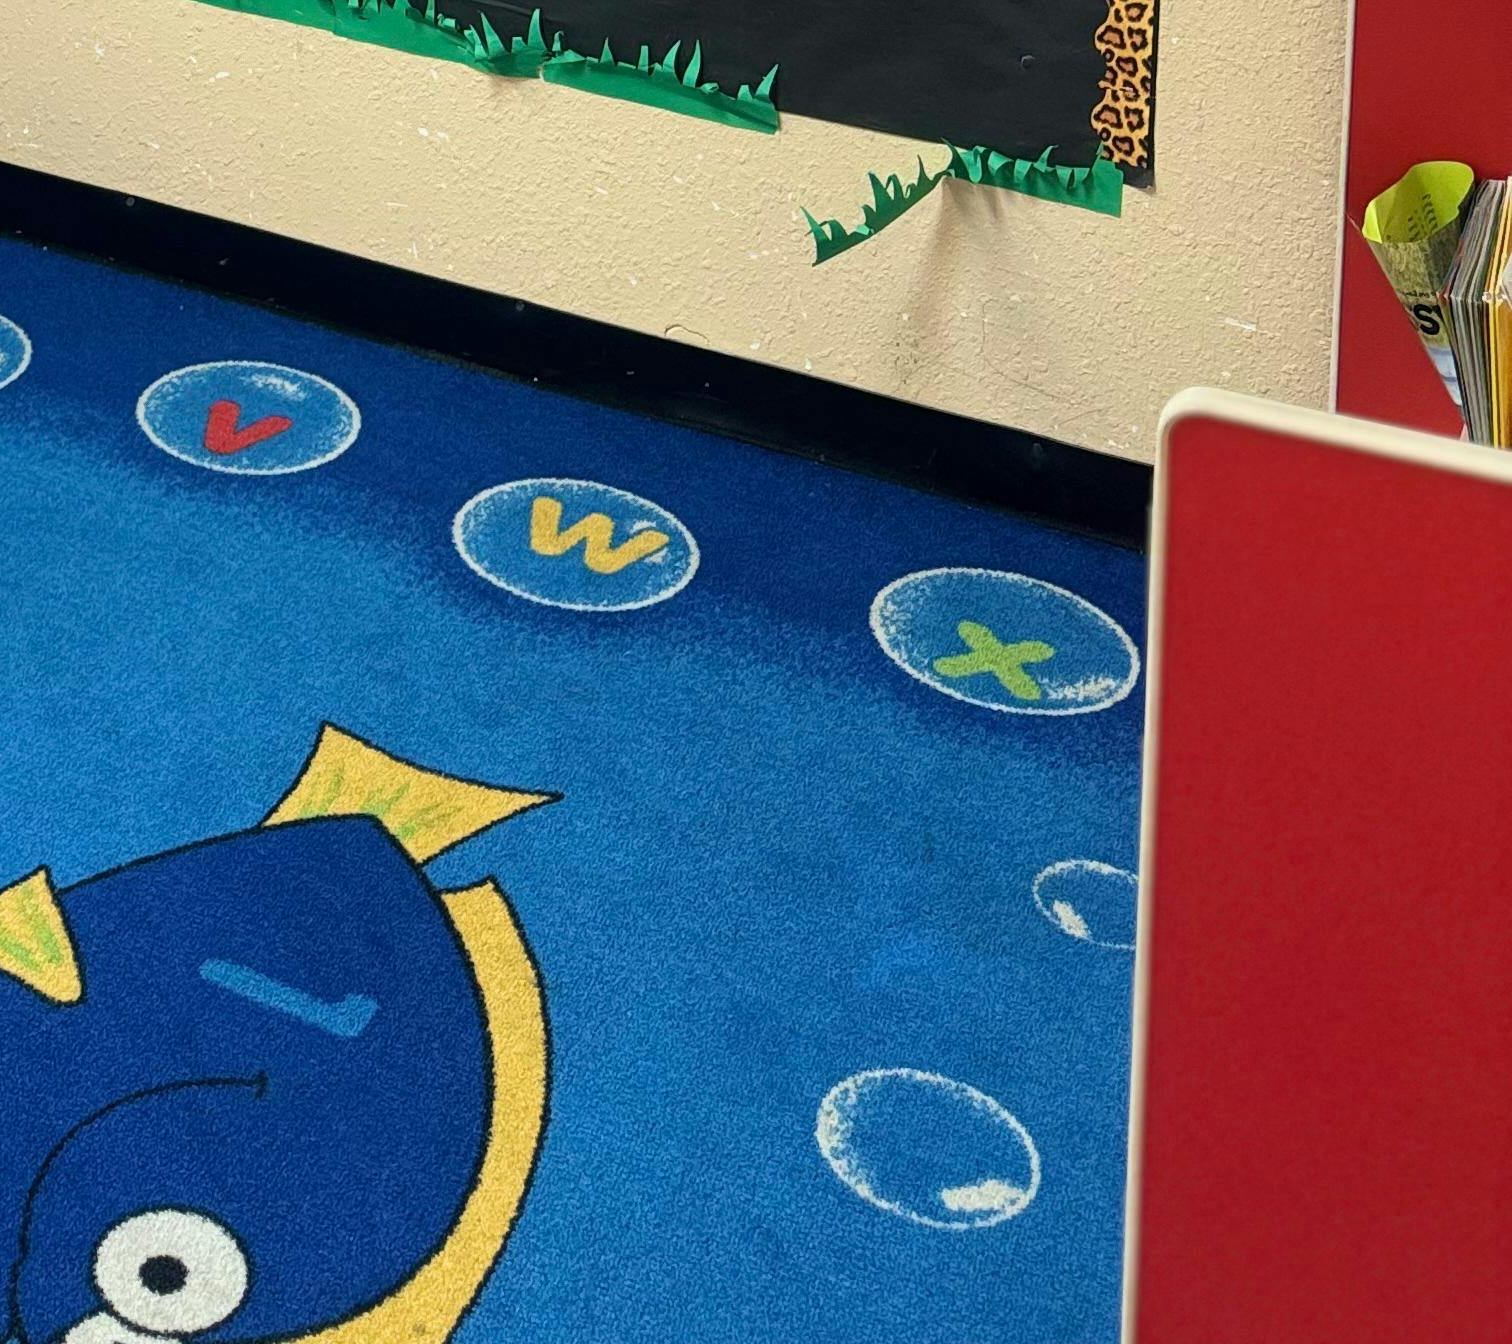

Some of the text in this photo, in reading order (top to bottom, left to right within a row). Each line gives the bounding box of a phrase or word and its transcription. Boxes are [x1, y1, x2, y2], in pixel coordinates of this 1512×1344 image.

[204, 398, 293, 455] v
[528, 495, 673, 576] w
[934, 621, 1057, 702] x
[198, 957, 380, 1038] 1
